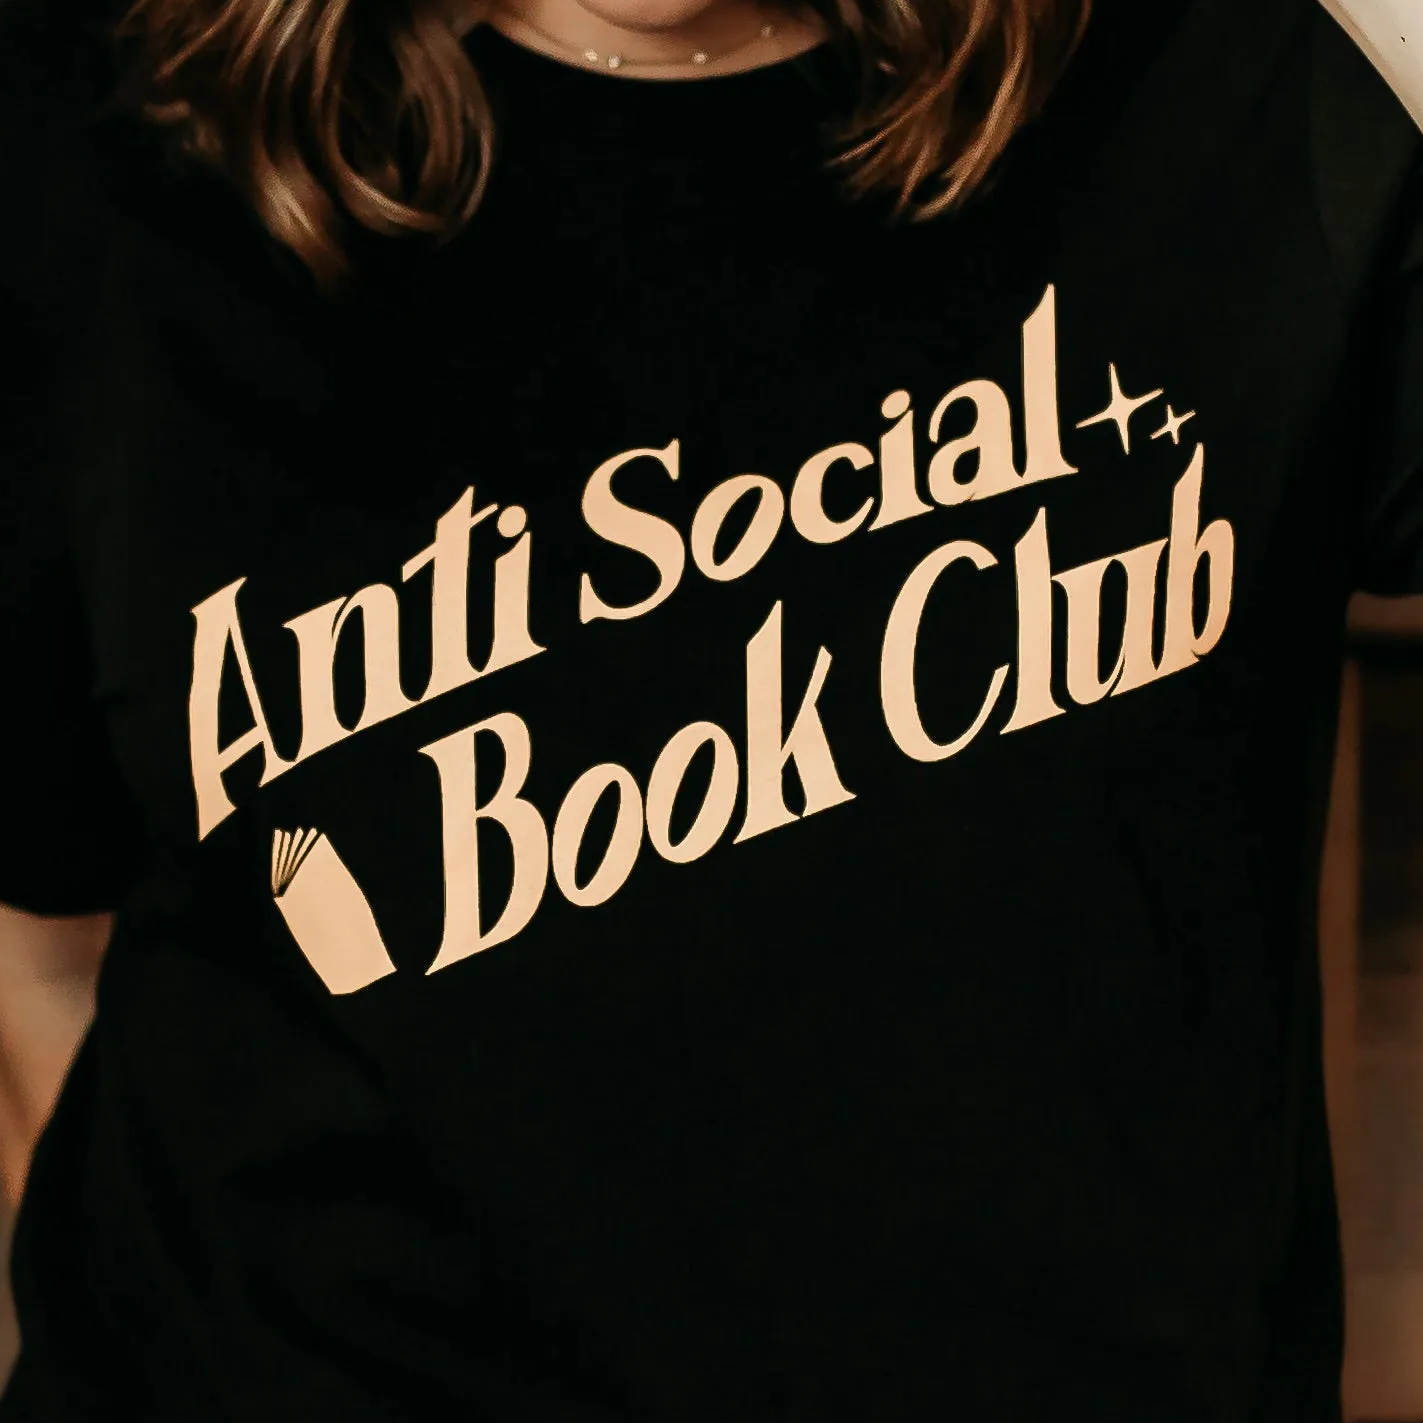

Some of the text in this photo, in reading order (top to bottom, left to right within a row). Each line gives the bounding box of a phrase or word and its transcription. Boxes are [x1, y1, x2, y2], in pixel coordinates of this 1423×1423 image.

[188, 283, 1079, 843] Anti Social
[417, 442, 1235, 976] Book Club
